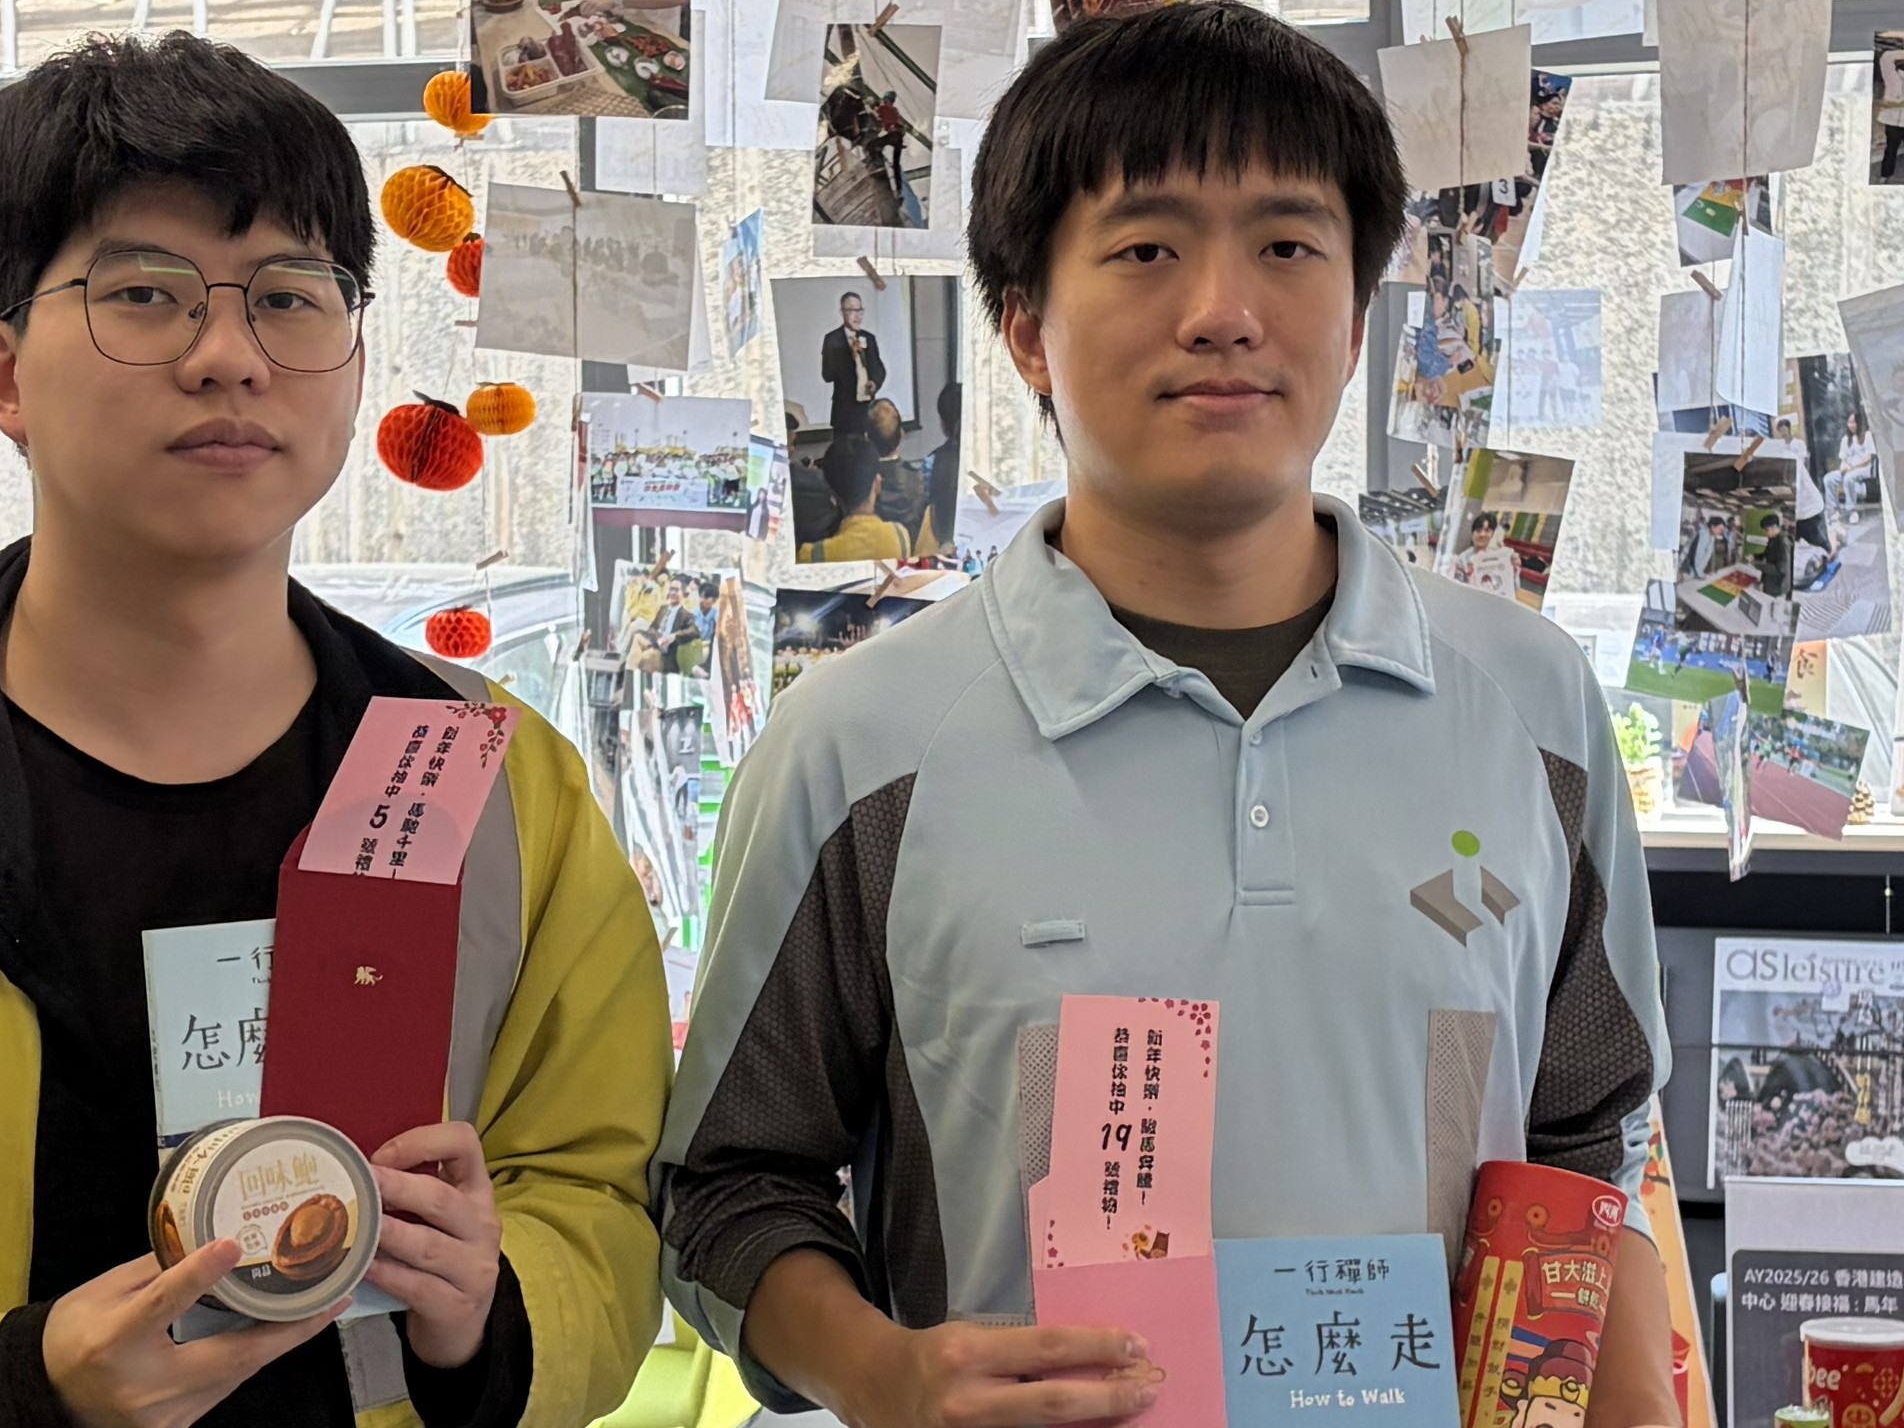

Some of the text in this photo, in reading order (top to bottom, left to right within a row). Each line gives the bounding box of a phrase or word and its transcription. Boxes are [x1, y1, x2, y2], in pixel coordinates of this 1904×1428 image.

[1499, 179, 1509, 195] 3
[369, 803, 391, 829] 5
[1101, 1122, 1133, 1152] 19
[1274, 1258, 1390, 1284] 一行禪師
[1744, 1267, 1830, 1287] AY2025/26
[1741, 1292, 1776, 1312] 中心
[1240, 1310, 1441, 1377] 怎麼走
[1290, 1387, 1406, 1409] How to Walk
